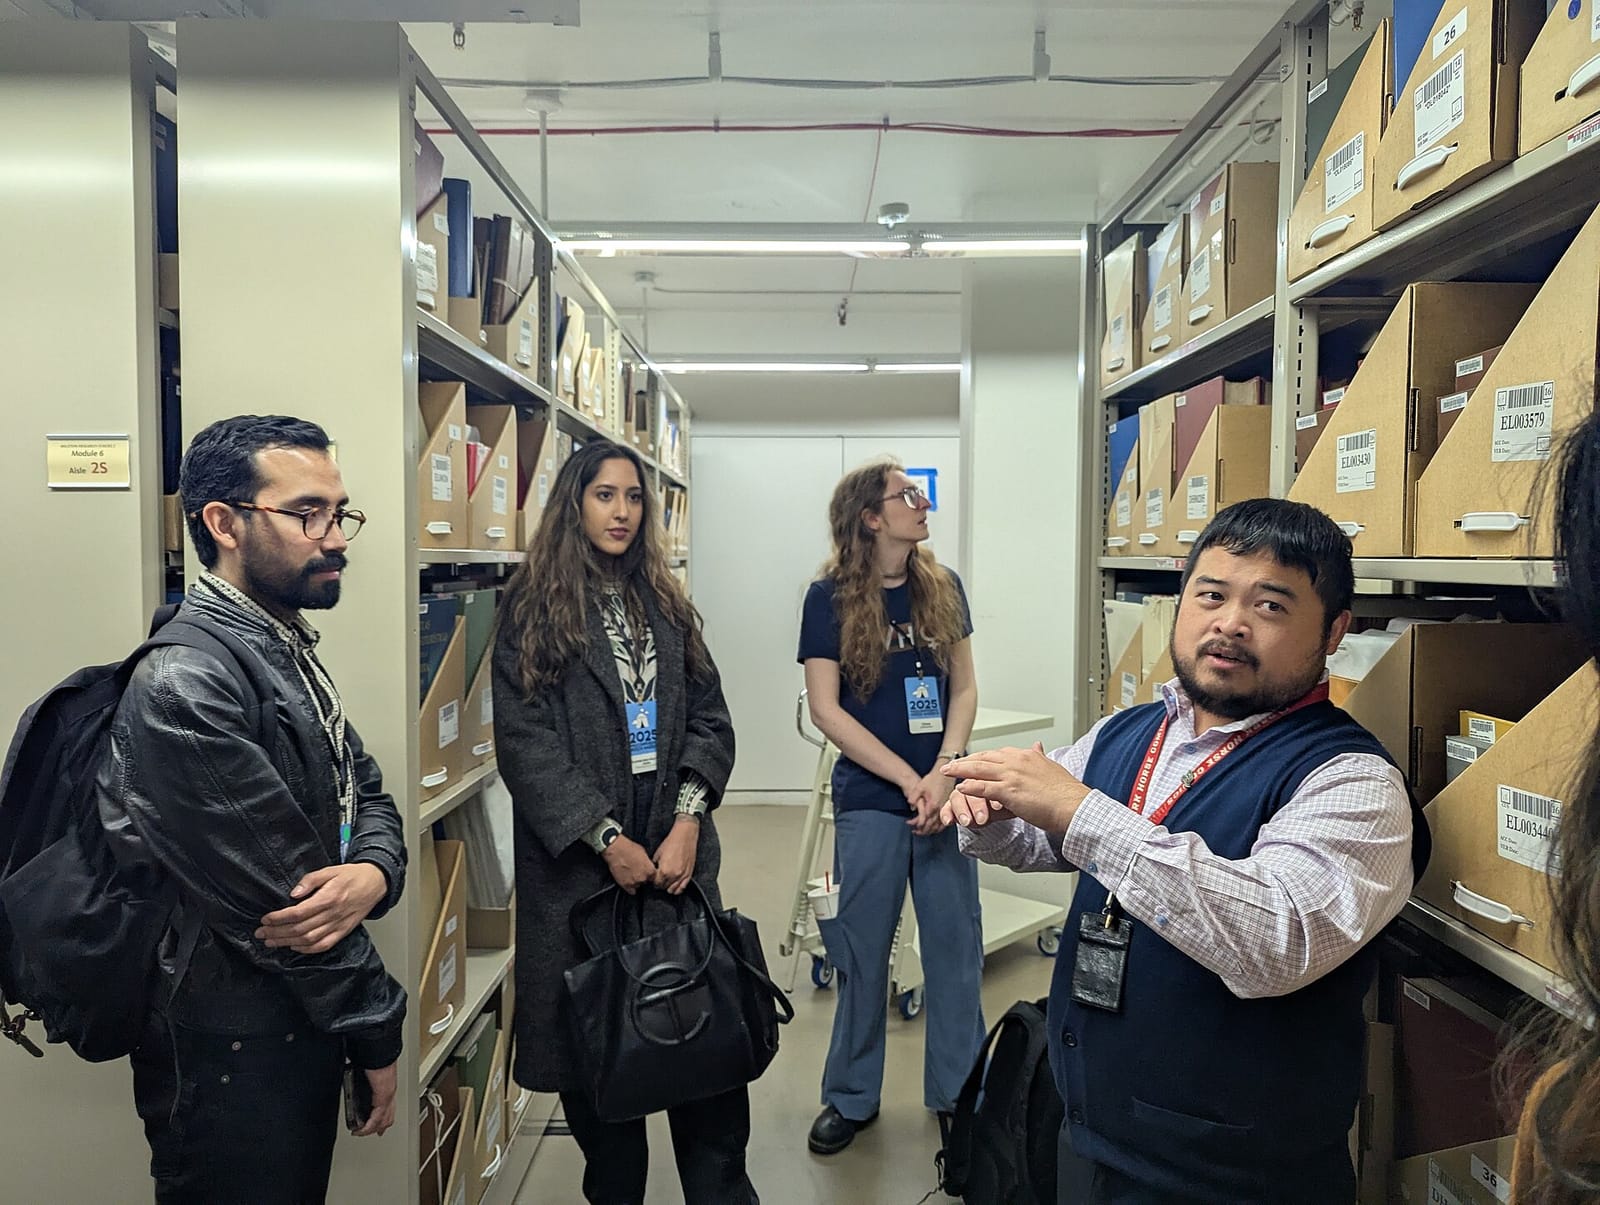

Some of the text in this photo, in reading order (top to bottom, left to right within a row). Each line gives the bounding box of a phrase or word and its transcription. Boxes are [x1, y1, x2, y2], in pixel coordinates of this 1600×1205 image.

[1444, 25, 1456, 46] 26
[1544, 386, 1552, 396] 16
[1500, 411, 1545, 431] EL003579
[909, 699, 938, 710] 2025
[1206, 735, 1243, 767] HORSE
[1136, 757, 1155, 792] HORSE
[1483, 1167, 1497, 1188] 36
